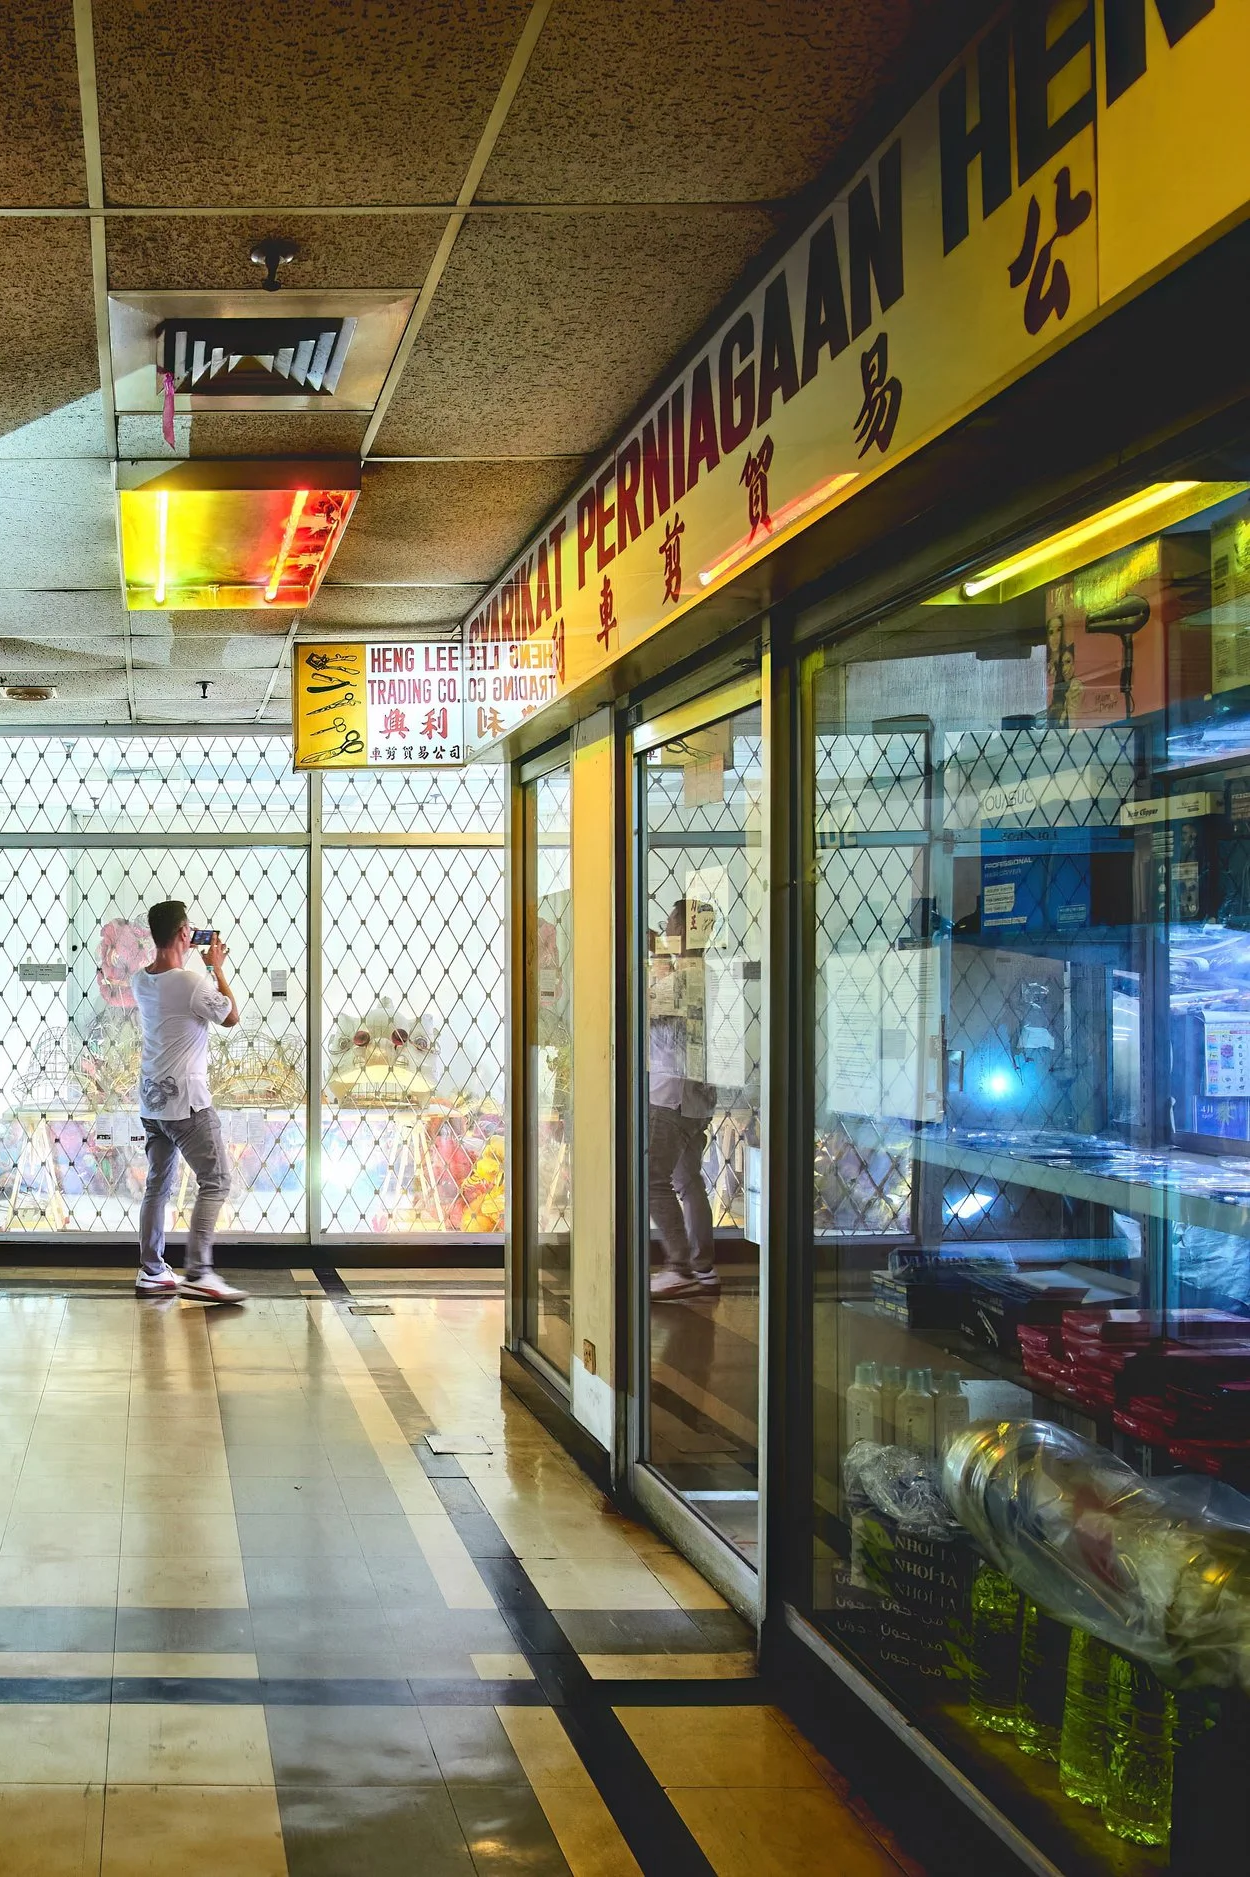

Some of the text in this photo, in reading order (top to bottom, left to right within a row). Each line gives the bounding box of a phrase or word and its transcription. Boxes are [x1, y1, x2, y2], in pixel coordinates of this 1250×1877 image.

[577, 138, 904, 590] PERNIAGAAN
[371, 646, 459, 673] HENG LEE
[368, 678, 461, 704] TRADING CO.
